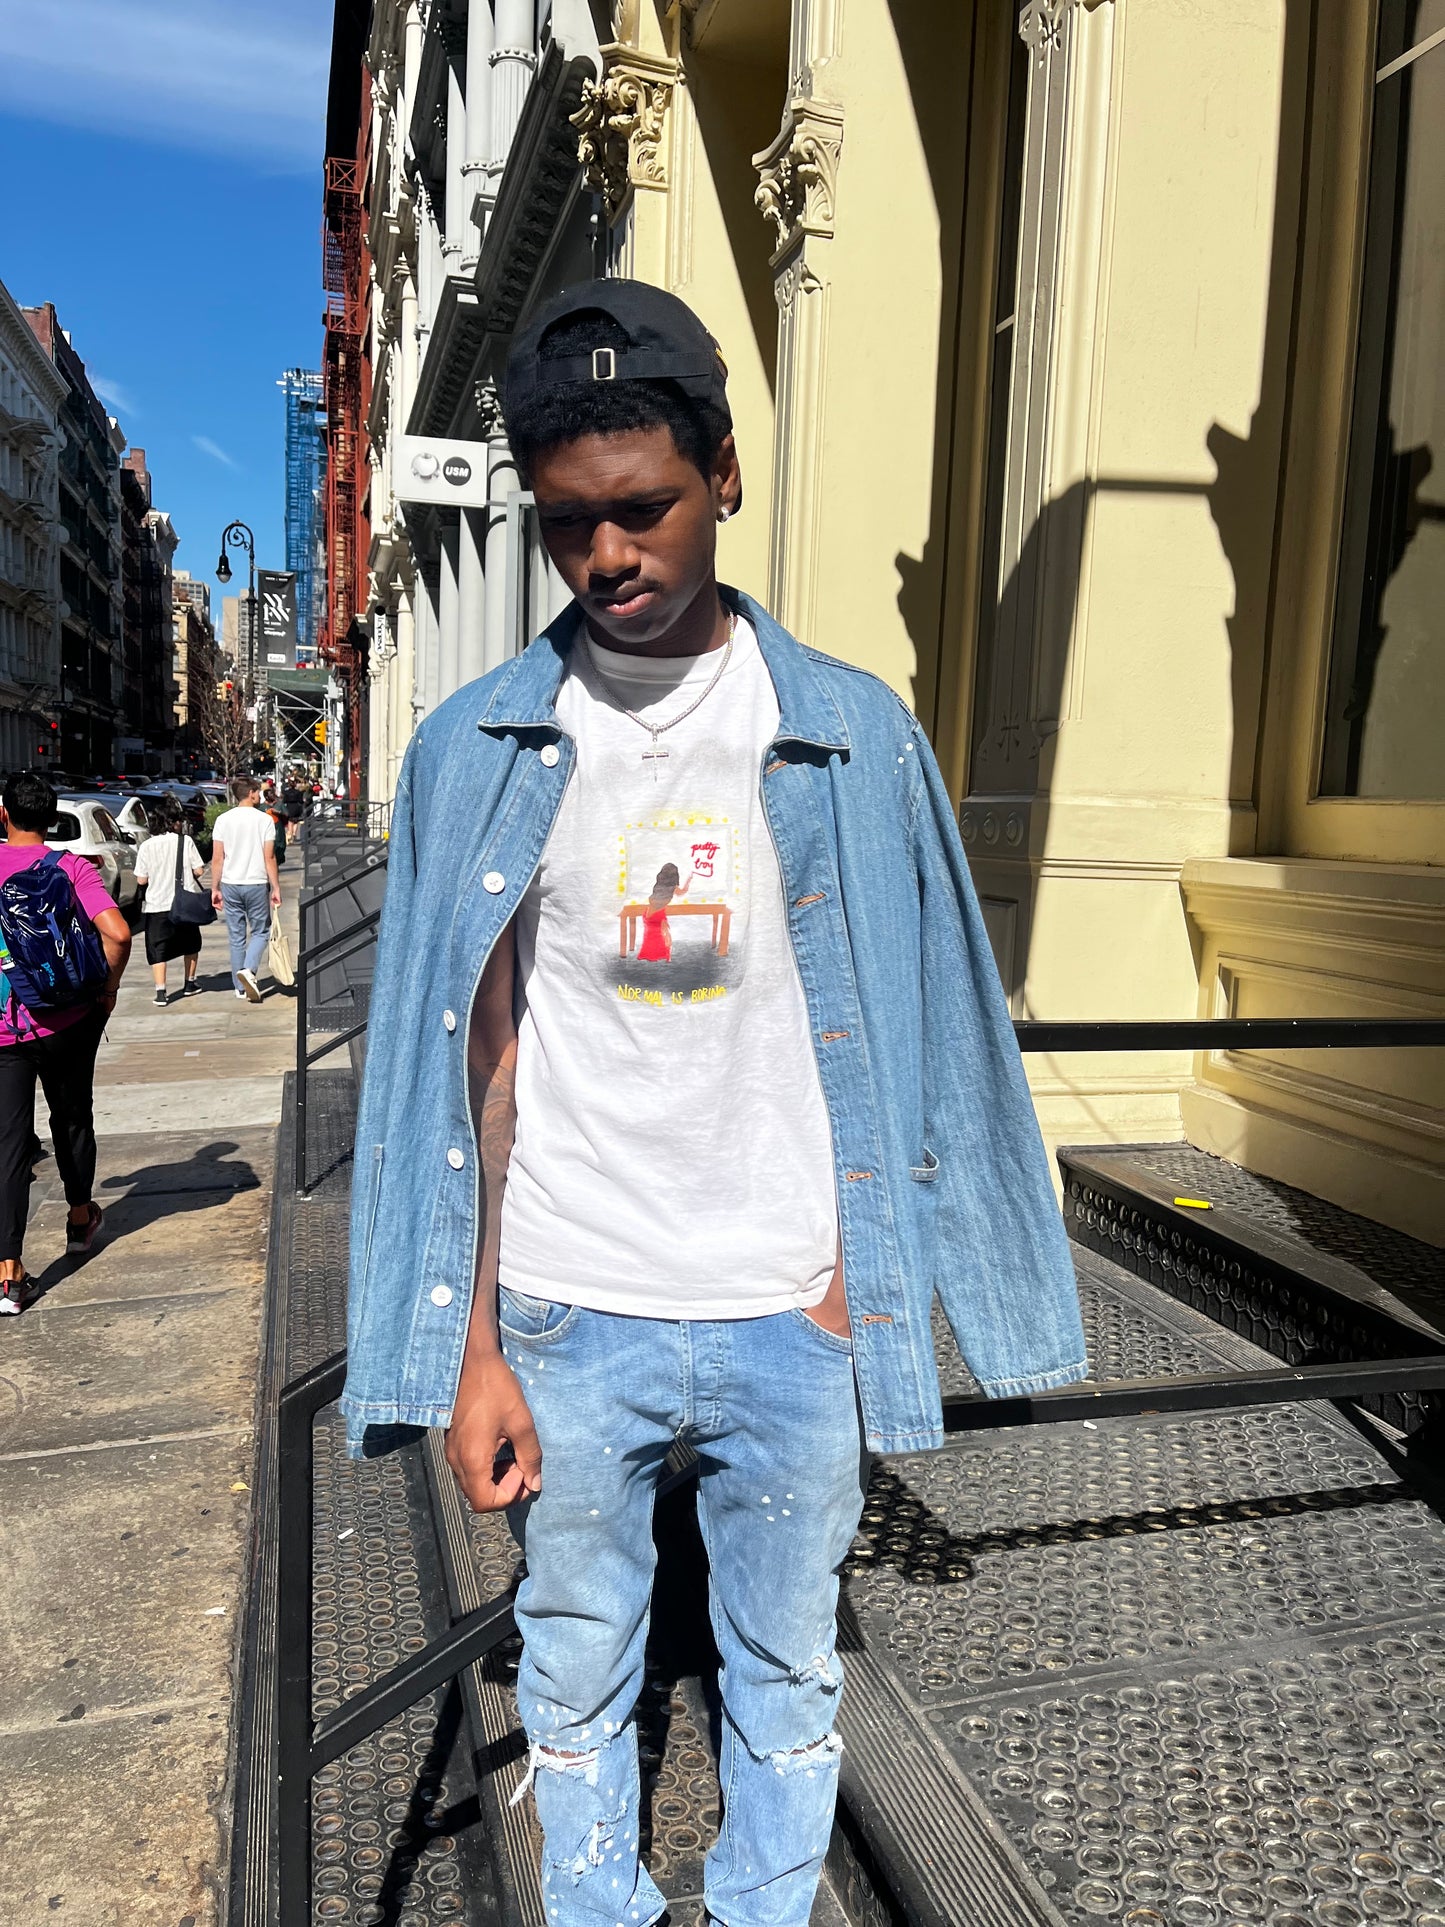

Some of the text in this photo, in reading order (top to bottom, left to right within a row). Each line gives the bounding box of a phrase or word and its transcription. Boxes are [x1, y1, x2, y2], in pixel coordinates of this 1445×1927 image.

[445, 466, 469, 477] USM
[690, 842, 720, 860] pretty
[617, 983, 663, 1007] NORMAL
[672, 991, 684, 1005] IS
